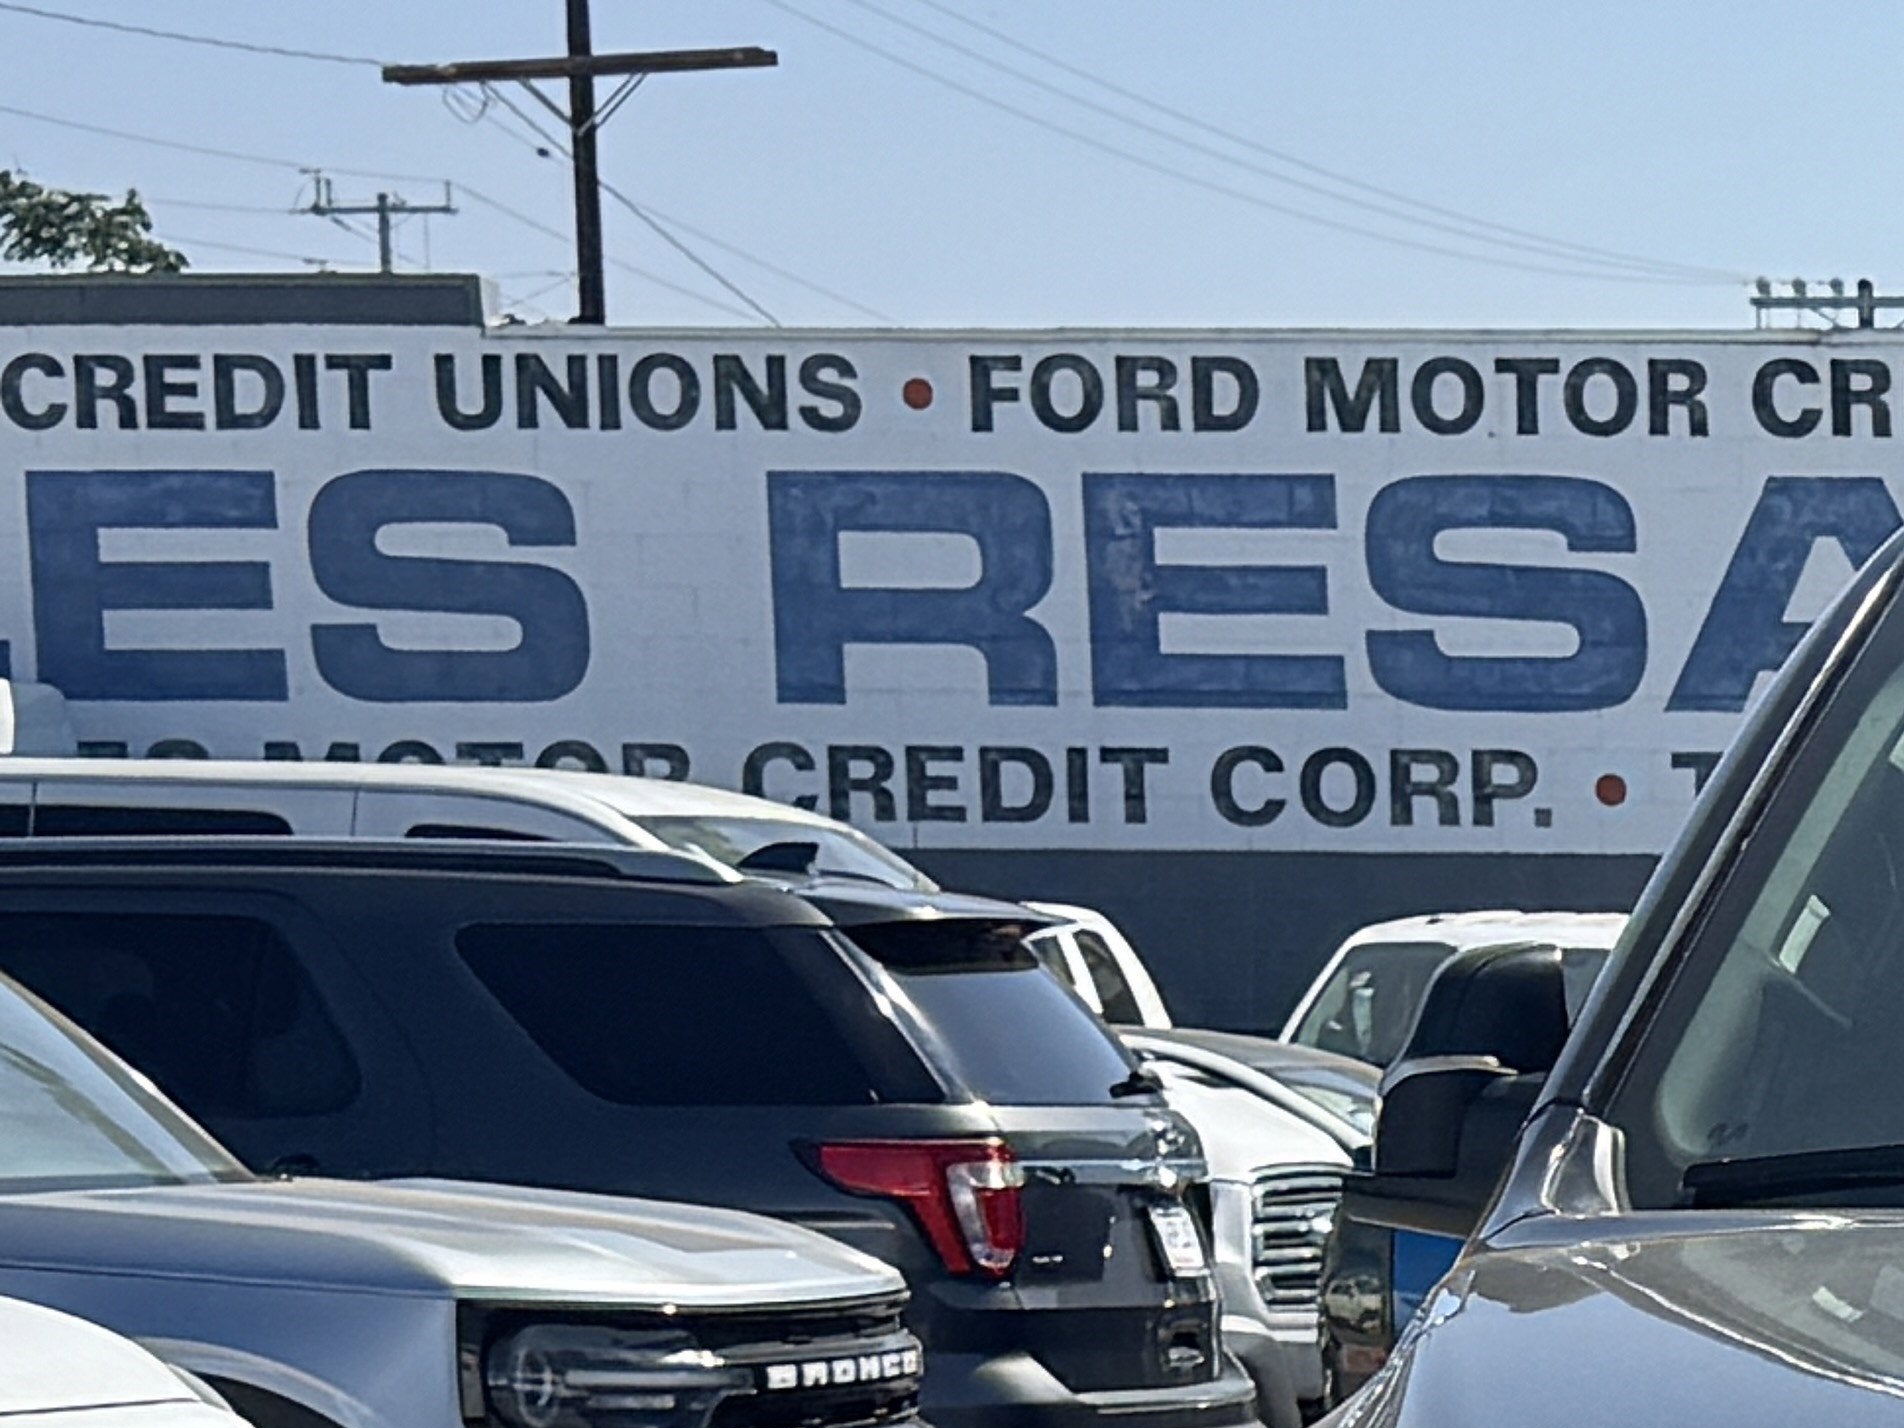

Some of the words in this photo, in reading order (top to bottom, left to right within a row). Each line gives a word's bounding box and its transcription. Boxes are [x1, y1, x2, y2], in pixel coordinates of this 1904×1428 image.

[0, 353, 392, 431] CREDIT
[434, 353, 862, 432] UNIONS
[969, 354, 1259, 434] FORD
[1305, 357, 1709, 437] MOTOR
[0, 469, 591, 702] ES
[741, 742, 1169, 824] CREDIT
[1210, 745, 1553, 829] CORP.
[766, 1350, 918, 1390] BRONCO
